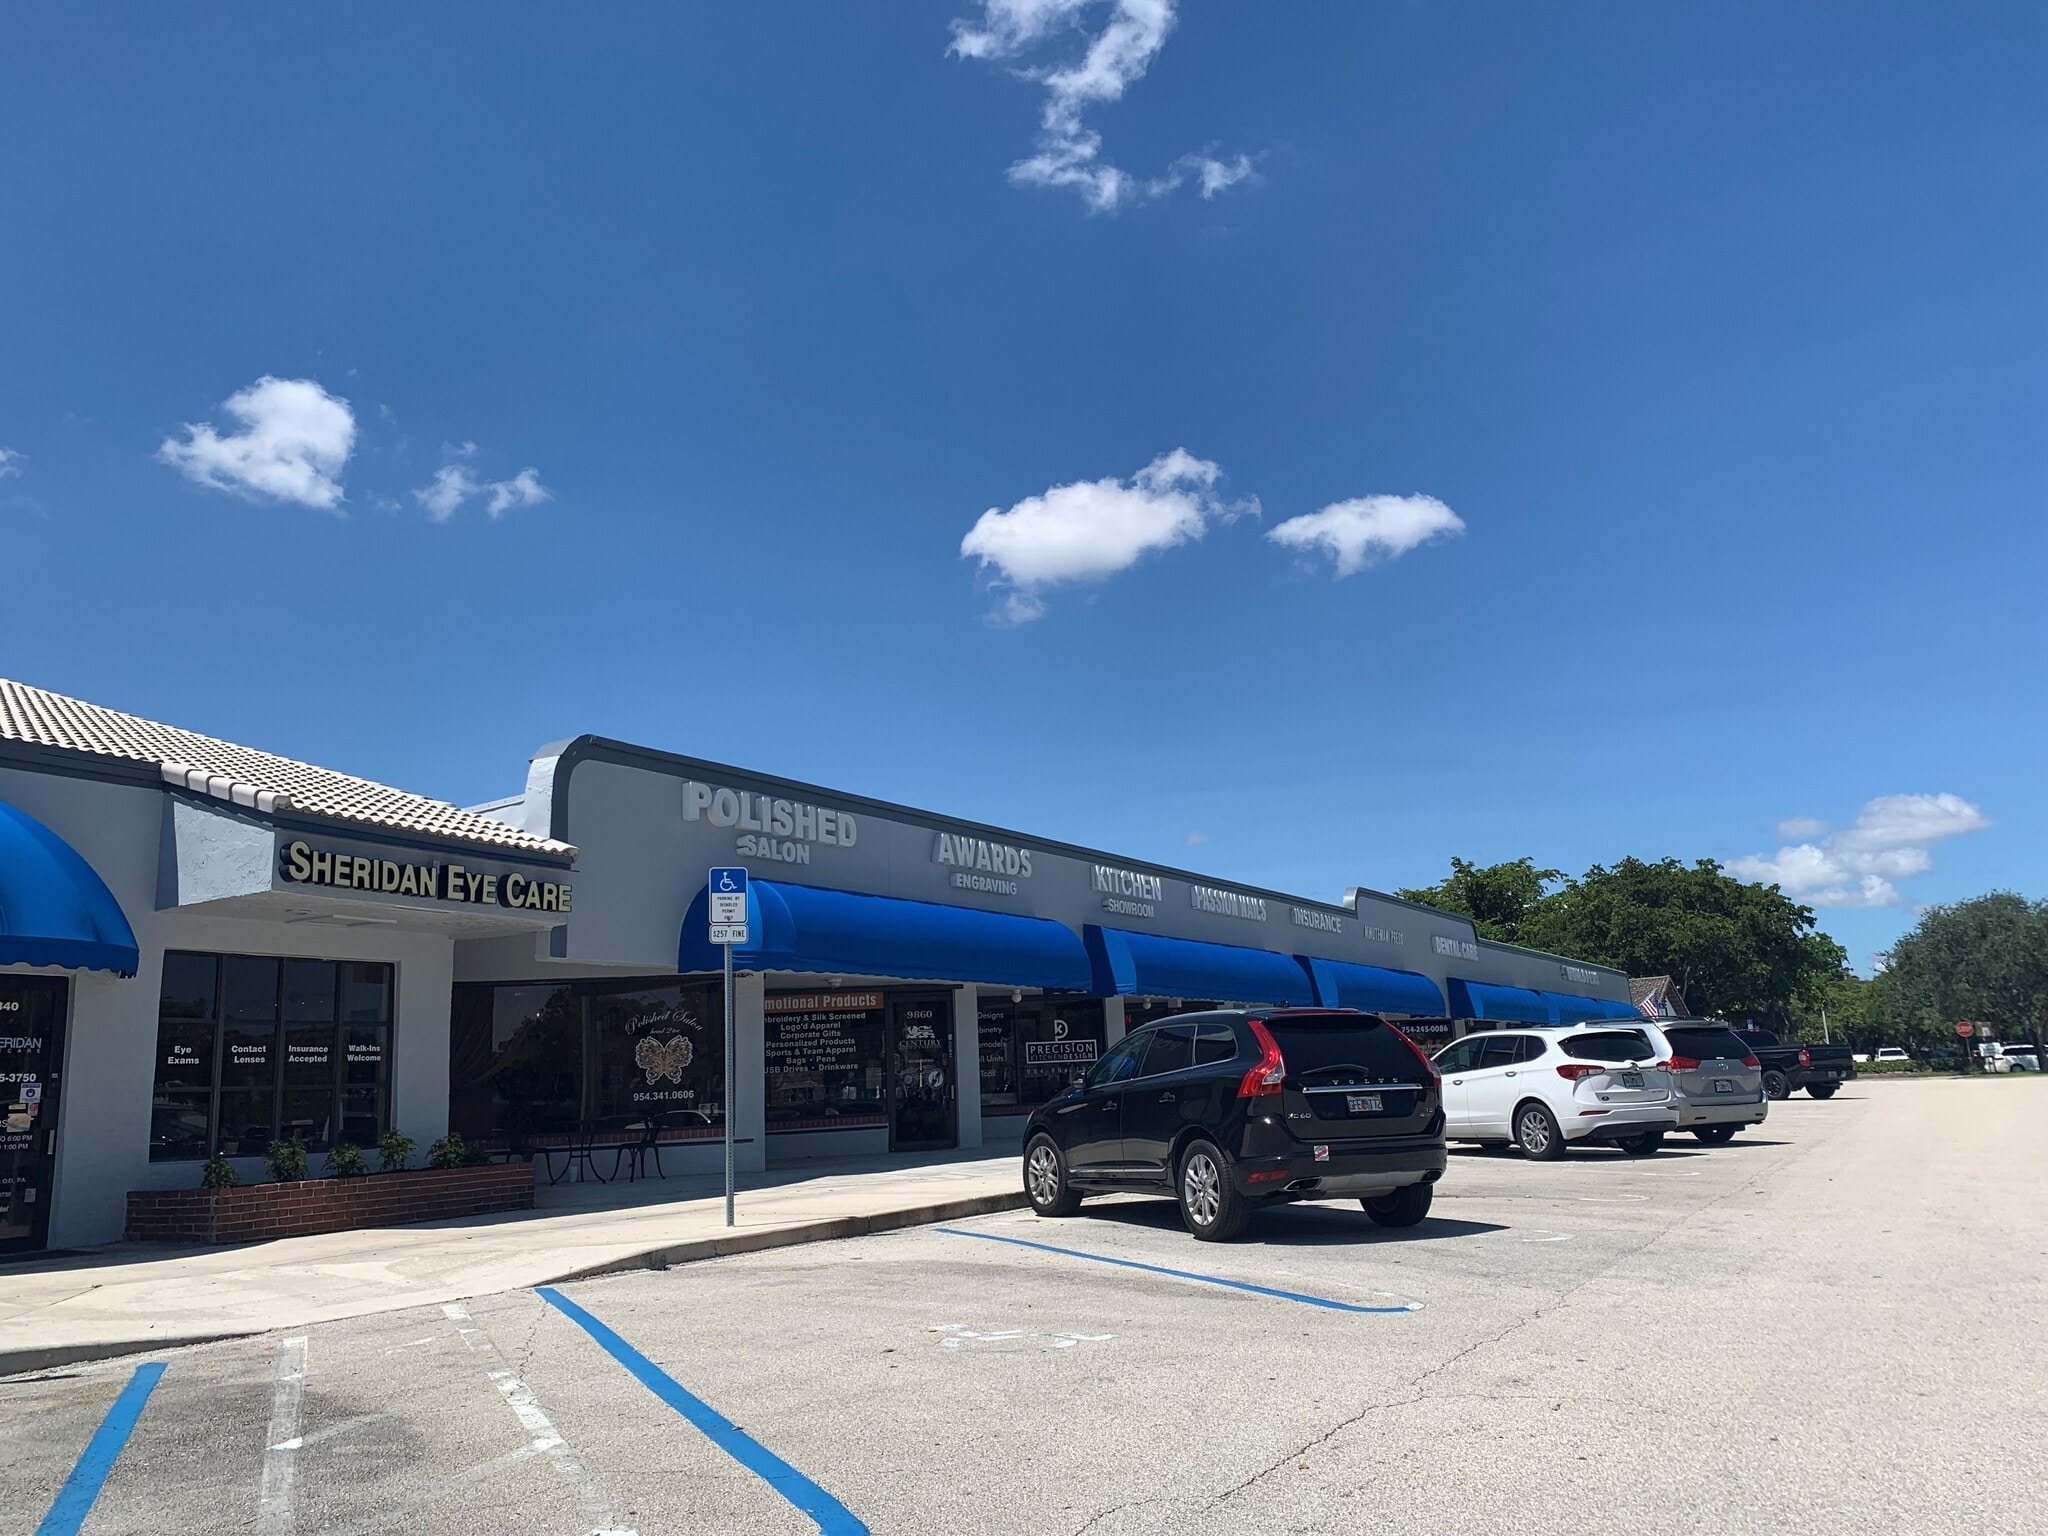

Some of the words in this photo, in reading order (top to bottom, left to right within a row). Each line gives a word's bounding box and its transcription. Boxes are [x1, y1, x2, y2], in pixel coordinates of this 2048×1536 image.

[682, 781, 857, 847] POLISHED
[737, 835, 810, 865] SALON
[934, 833, 1032, 878] AWARDS
[287, 841, 437, 897] SHERIDAN
[447, 865, 498, 905] EYE
[506, 872, 572, 912] CARE
[953, 872, 1018, 896] ENGRAVING
[1093, 865, 1162, 901] KITCHEN
[1106, 898, 1155, 919] SHOWROOM
[1192, 885, 1238, 918] PASSION
[1239, 896, 1267, 922] NAILS
[1292, 907, 1342, 934] INSURANCE
[713, 930, 728, 938] $257
[732, 930, 745, 938] FINE
[823, 994, 877, 1008] Products
[829, 1012, 866, 1020] Screened
[906, 1010, 933, 1019] 9860
[625, 1010, 671, 1035] Polished
[672, 1009, 703, 1031] Salon
[780, 1023, 809, 1032] Logo'd
[810, 1022, 841, 1030] Apparel
[780, 1031, 820, 1040] Corporate
[822, 1029, 841, 1037] Gifts
[348, 1044, 381, 1052] Walk-Ins
[766, 1039, 818, 1048] Personalized
[820, 1038, 856, 1046] Products
[899, 1039, 942, 1048] CENTURY
[1030, 1042, 1093, 1054] PRECISION
[174, 1045, 192, 1055] Eye
[231, 1045, 267, 1053] Contact
[288, 1045, 329, 1053] Insurance
[766, 1049, 792, 1058] Sports
[825, 1046, 856, 1054] Apparel
[167, 1056, 200, 1065] Exams
[234, 1055, 266, 1064] Lenses
[288, 1055, 328, 1064] Accepted
[347, 1054, 382, 1062] Welcome
[786, 1057, 807, 1066] Bags
[816, 1055, 836, 1063] Pens
[783, 1065, 809, 1073] Drives
[818, 1063, 859, 1071] Drinkware
[1333, 1077, 1398, 1085] VOLVO
[633, 1090, 695, 1102] 954.341.0606
